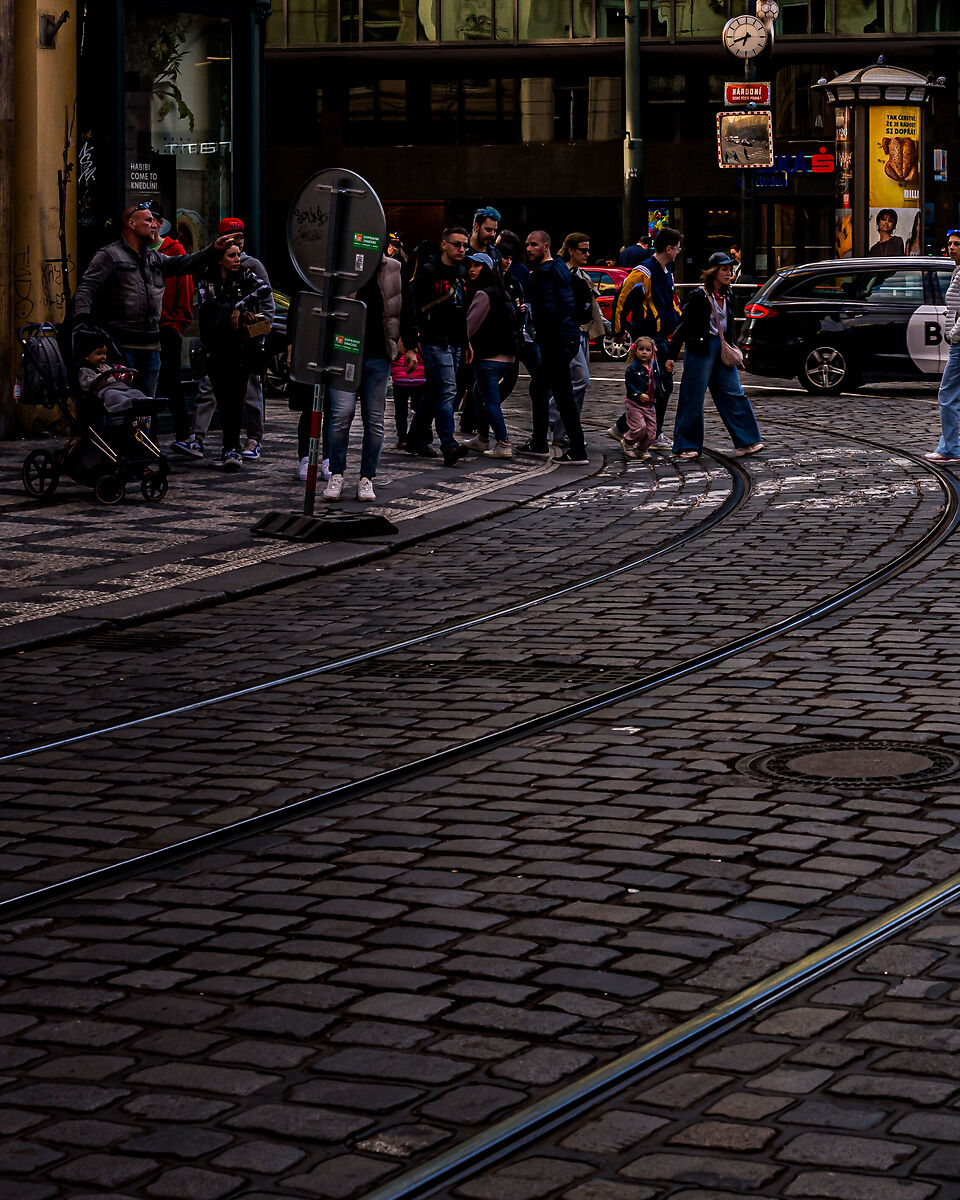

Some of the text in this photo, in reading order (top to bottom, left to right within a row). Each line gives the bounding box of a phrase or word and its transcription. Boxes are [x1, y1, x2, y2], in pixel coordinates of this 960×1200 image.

[732, 86, 762, 95] NÁRODNÍ
[130, 172, 158, 180] COME TO
[130, 180, 158, 190] KNEDLÍN!
